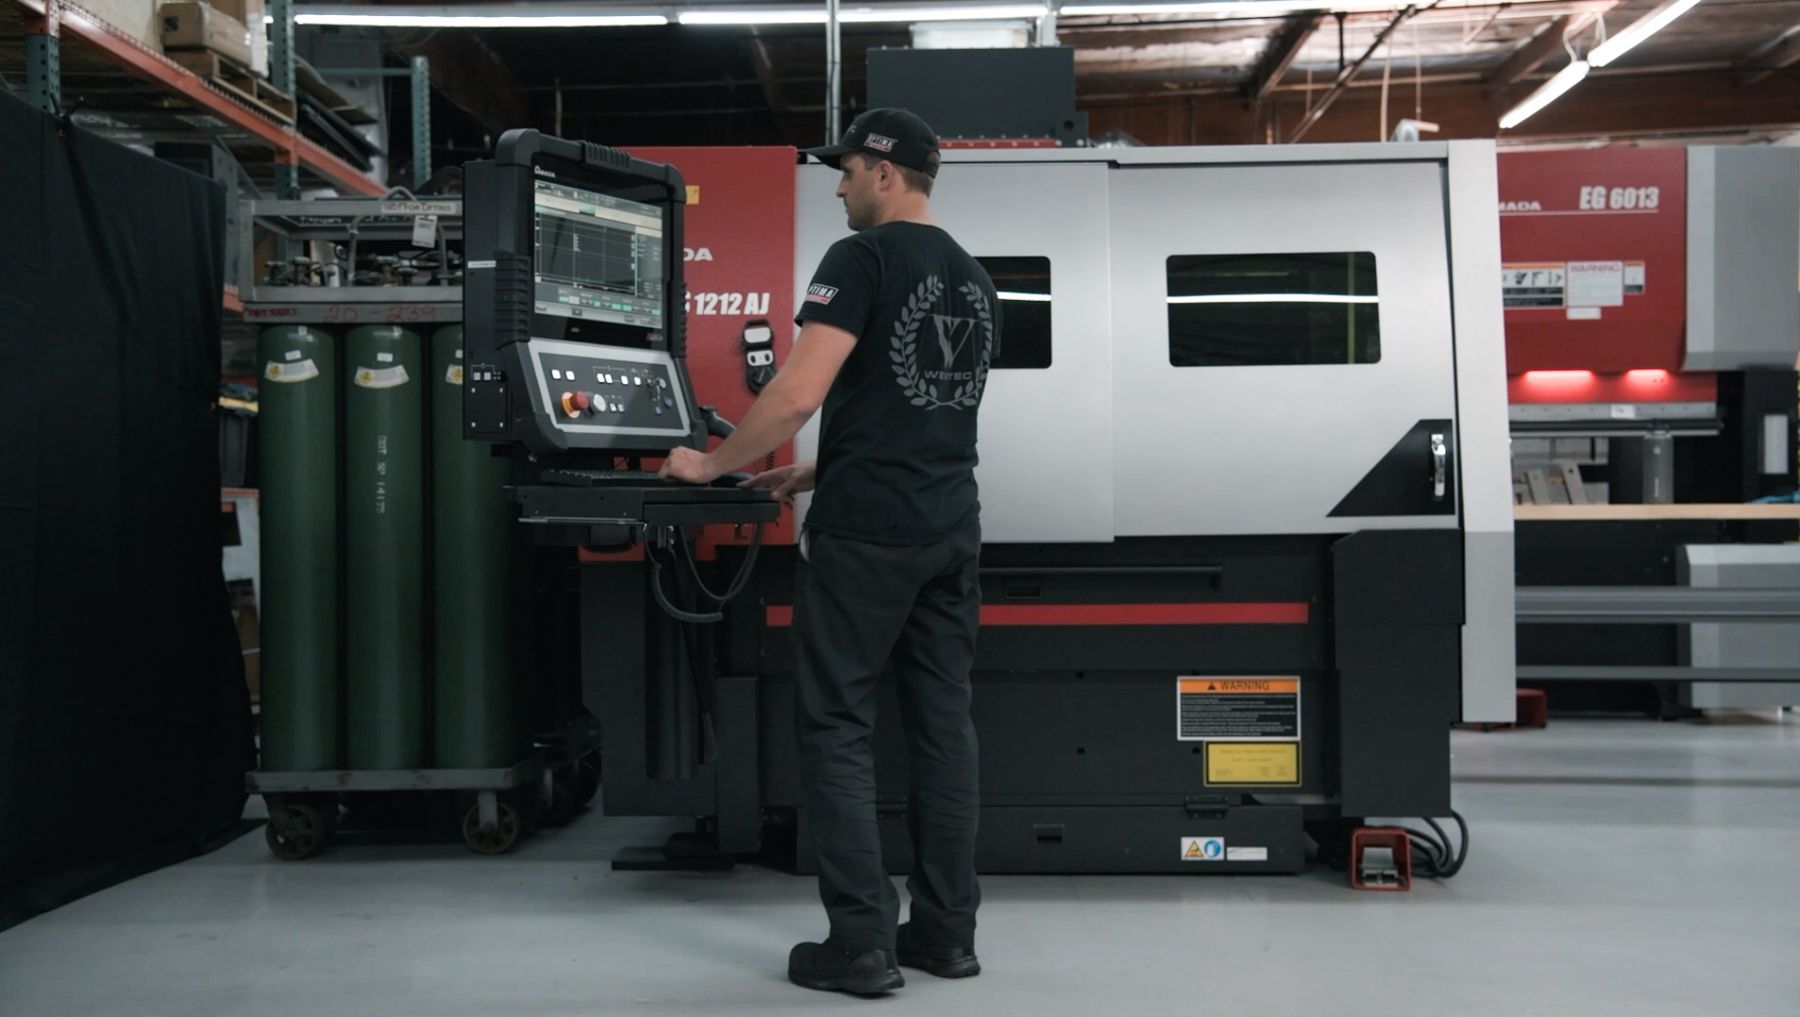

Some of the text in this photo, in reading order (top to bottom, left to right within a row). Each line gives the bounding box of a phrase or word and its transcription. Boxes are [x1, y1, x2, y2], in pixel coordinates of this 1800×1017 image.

[1498, 201, 1541, 211] MADA
[1579, 186, 1659, 210] EG 6013
[694, 292, 743, 315] 1212
[743, 291, 770, 315] AJ
[1221, 680, 1270, 691] WARNING
